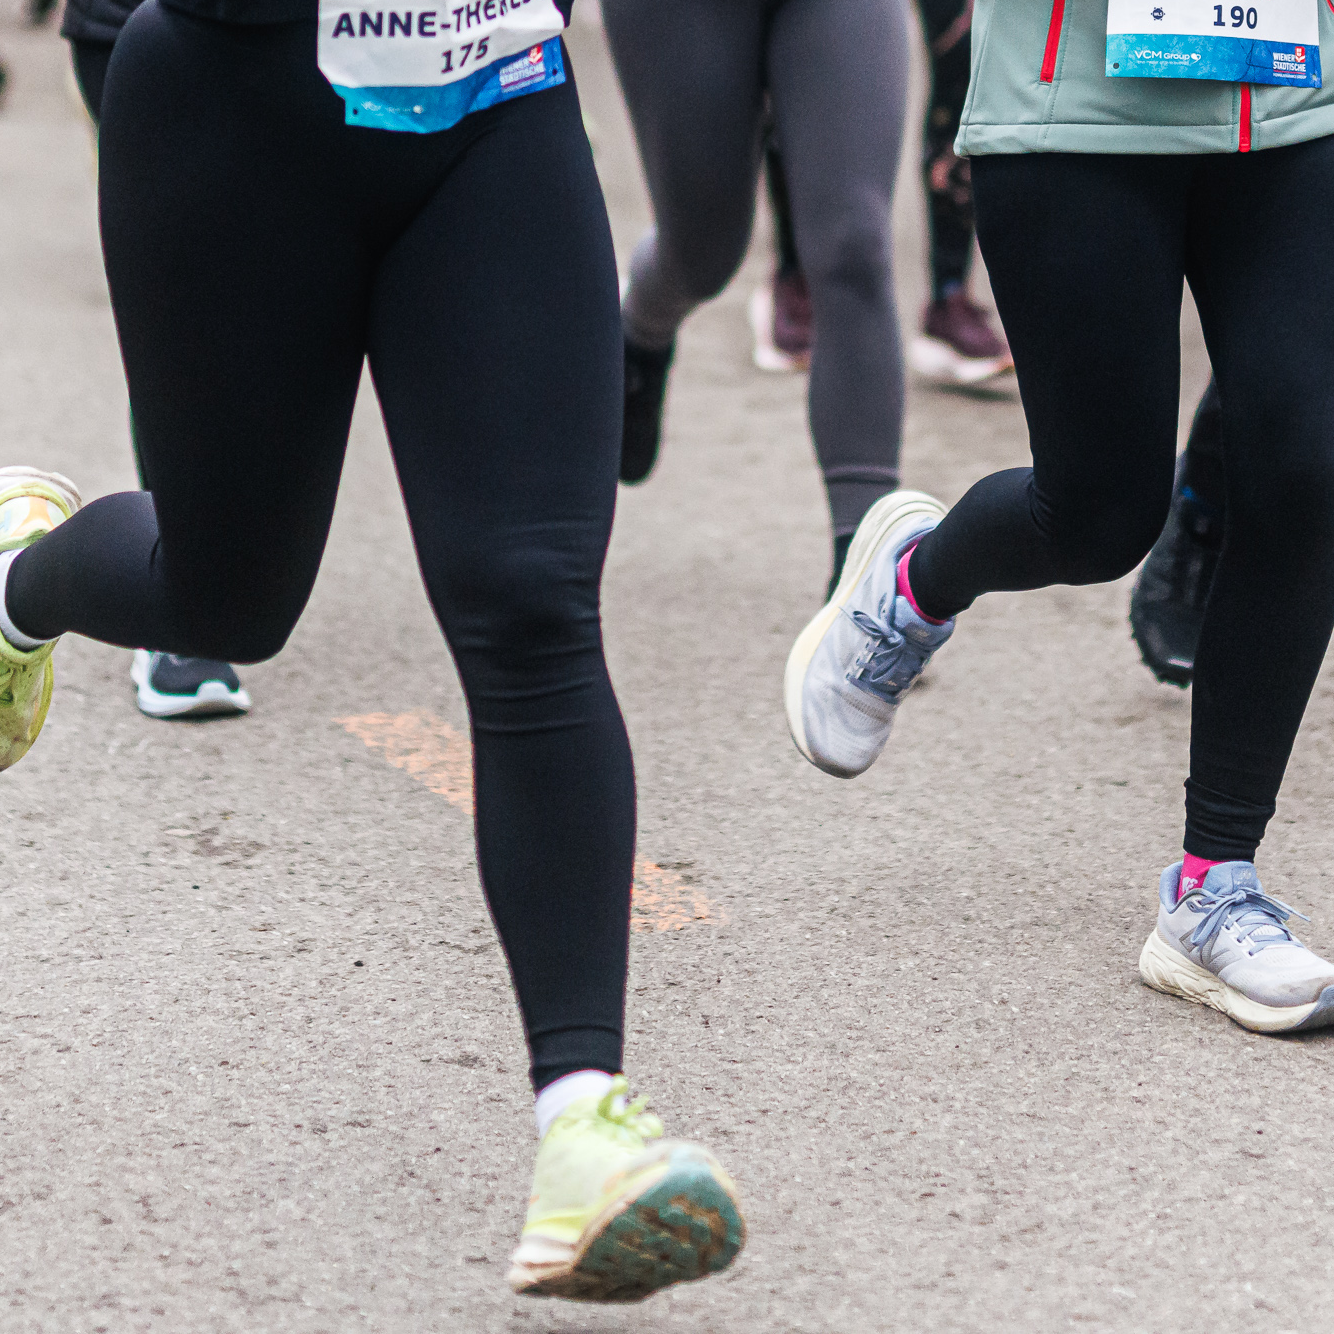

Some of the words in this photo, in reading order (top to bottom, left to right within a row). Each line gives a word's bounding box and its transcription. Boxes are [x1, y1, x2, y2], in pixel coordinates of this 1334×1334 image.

[1213, 4, 1258, 30] 190
[441, 36, 490, 74] 175
[1134, 50, 1162, 59] VCM
[1164, 52, 1190, 61] Group
[1273, 52, 1297, 62] WIENER
